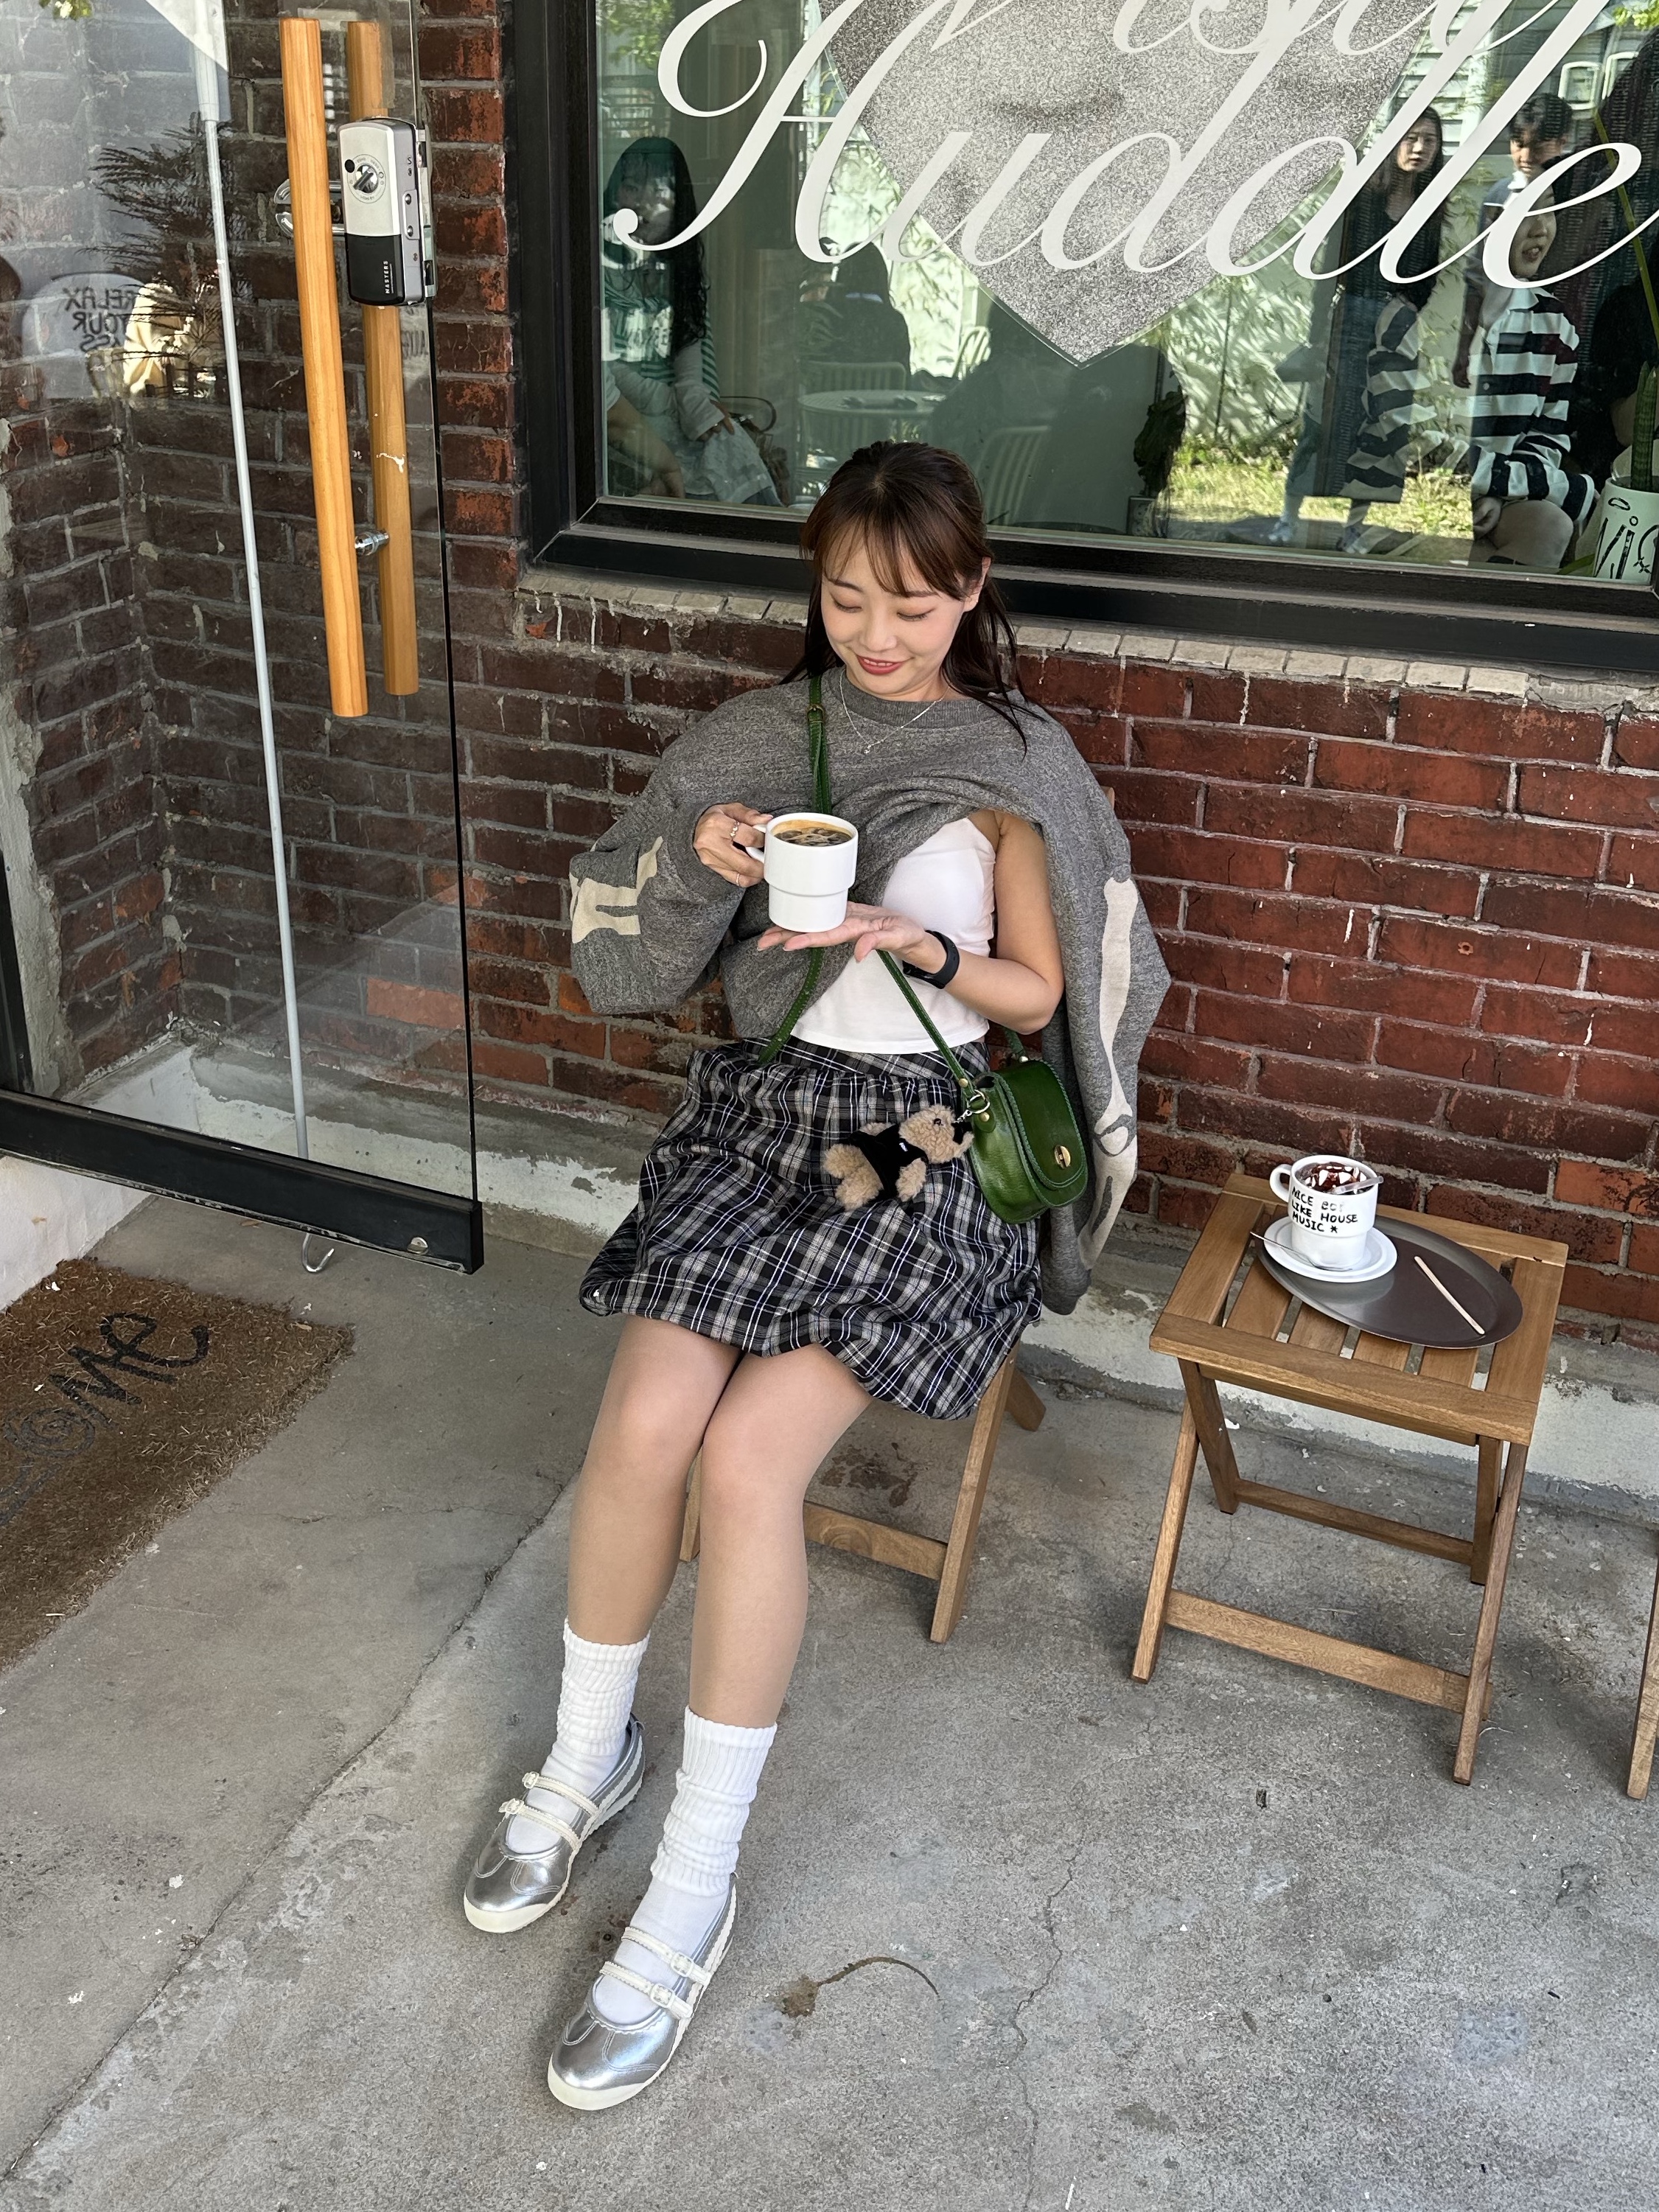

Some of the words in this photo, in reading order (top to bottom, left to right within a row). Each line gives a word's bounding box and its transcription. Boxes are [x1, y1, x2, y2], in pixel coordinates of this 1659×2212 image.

[612, 0, 1659, 290] Huddle
[1291, 1186, 1314, 1207] NICE
[1291, 1199, 1313, 1218] LIKE
[1320, 1212, 1358, 1224] HOUSE
[1292, 1210, 1325, 1232] MUSIC
